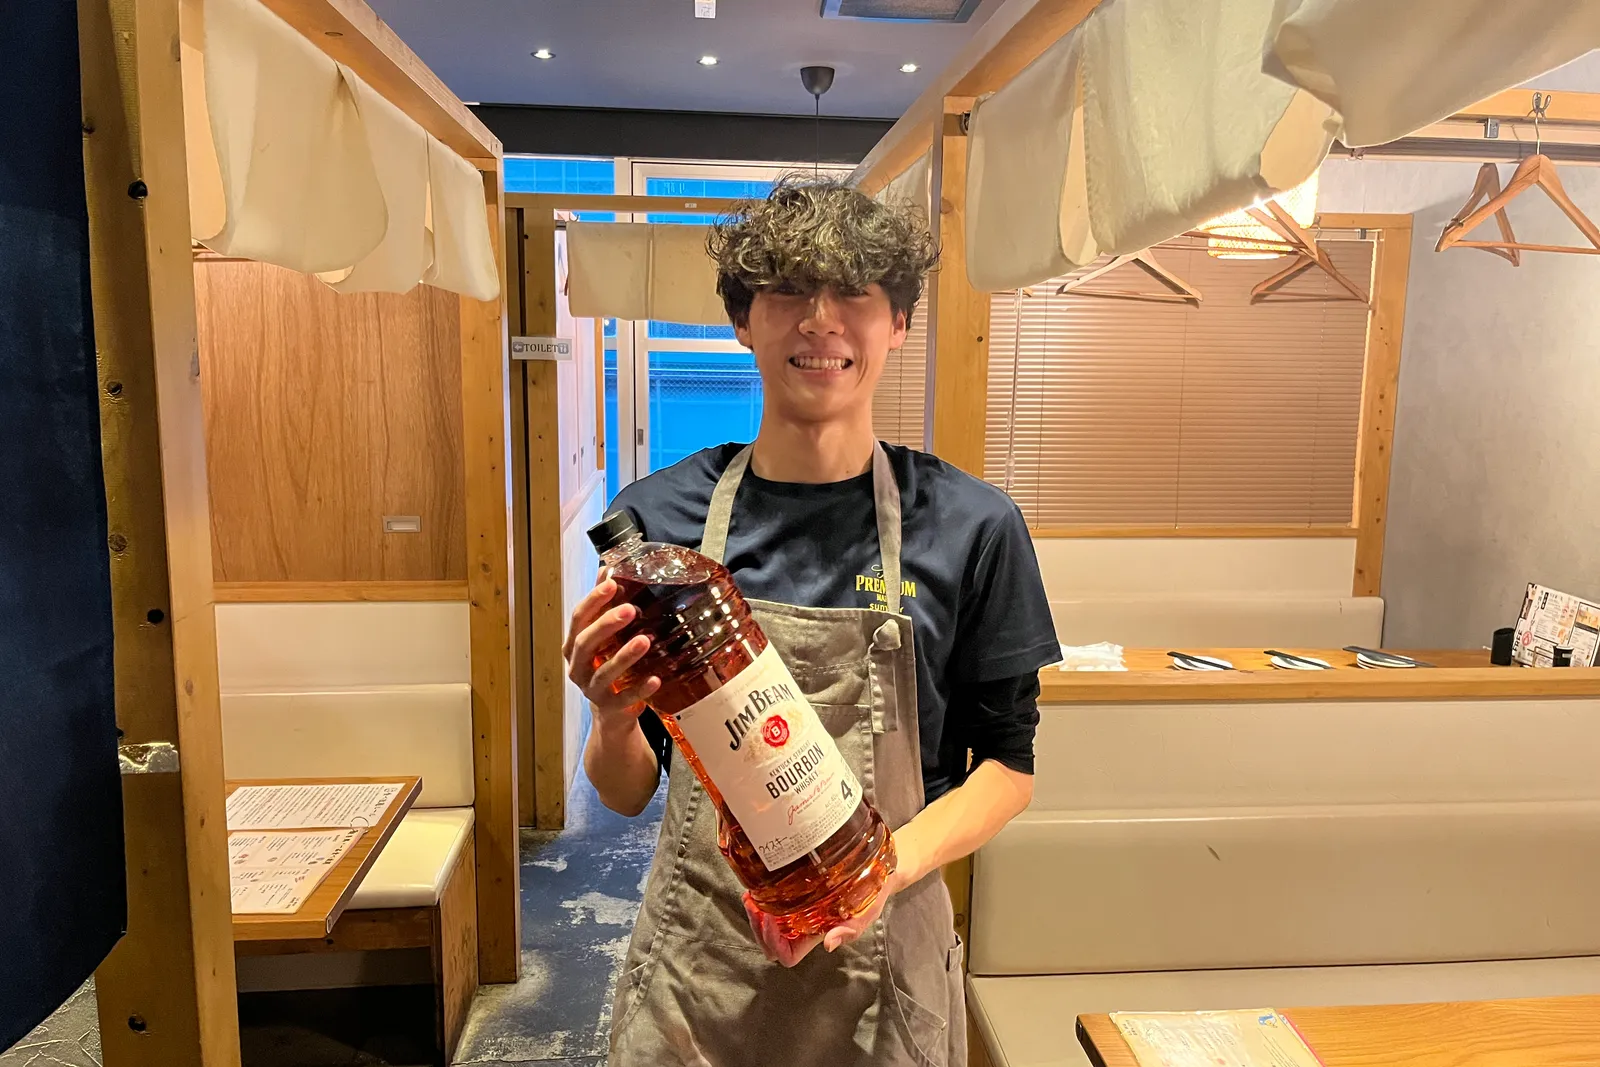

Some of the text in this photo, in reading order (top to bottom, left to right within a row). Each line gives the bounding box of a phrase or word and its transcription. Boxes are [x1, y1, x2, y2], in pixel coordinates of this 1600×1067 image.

[524, 343, 558, 353] TOILET
[724, 704, 757, 751] JIM
[748, 683, 796, 715] BEAM
[765, 741, 825, 799] BOURBON
[769, 757, 794, 777] KENTUCKY
[793, 770, 820, 795] WHISKEY
[840, 779, 853, 801] 4
